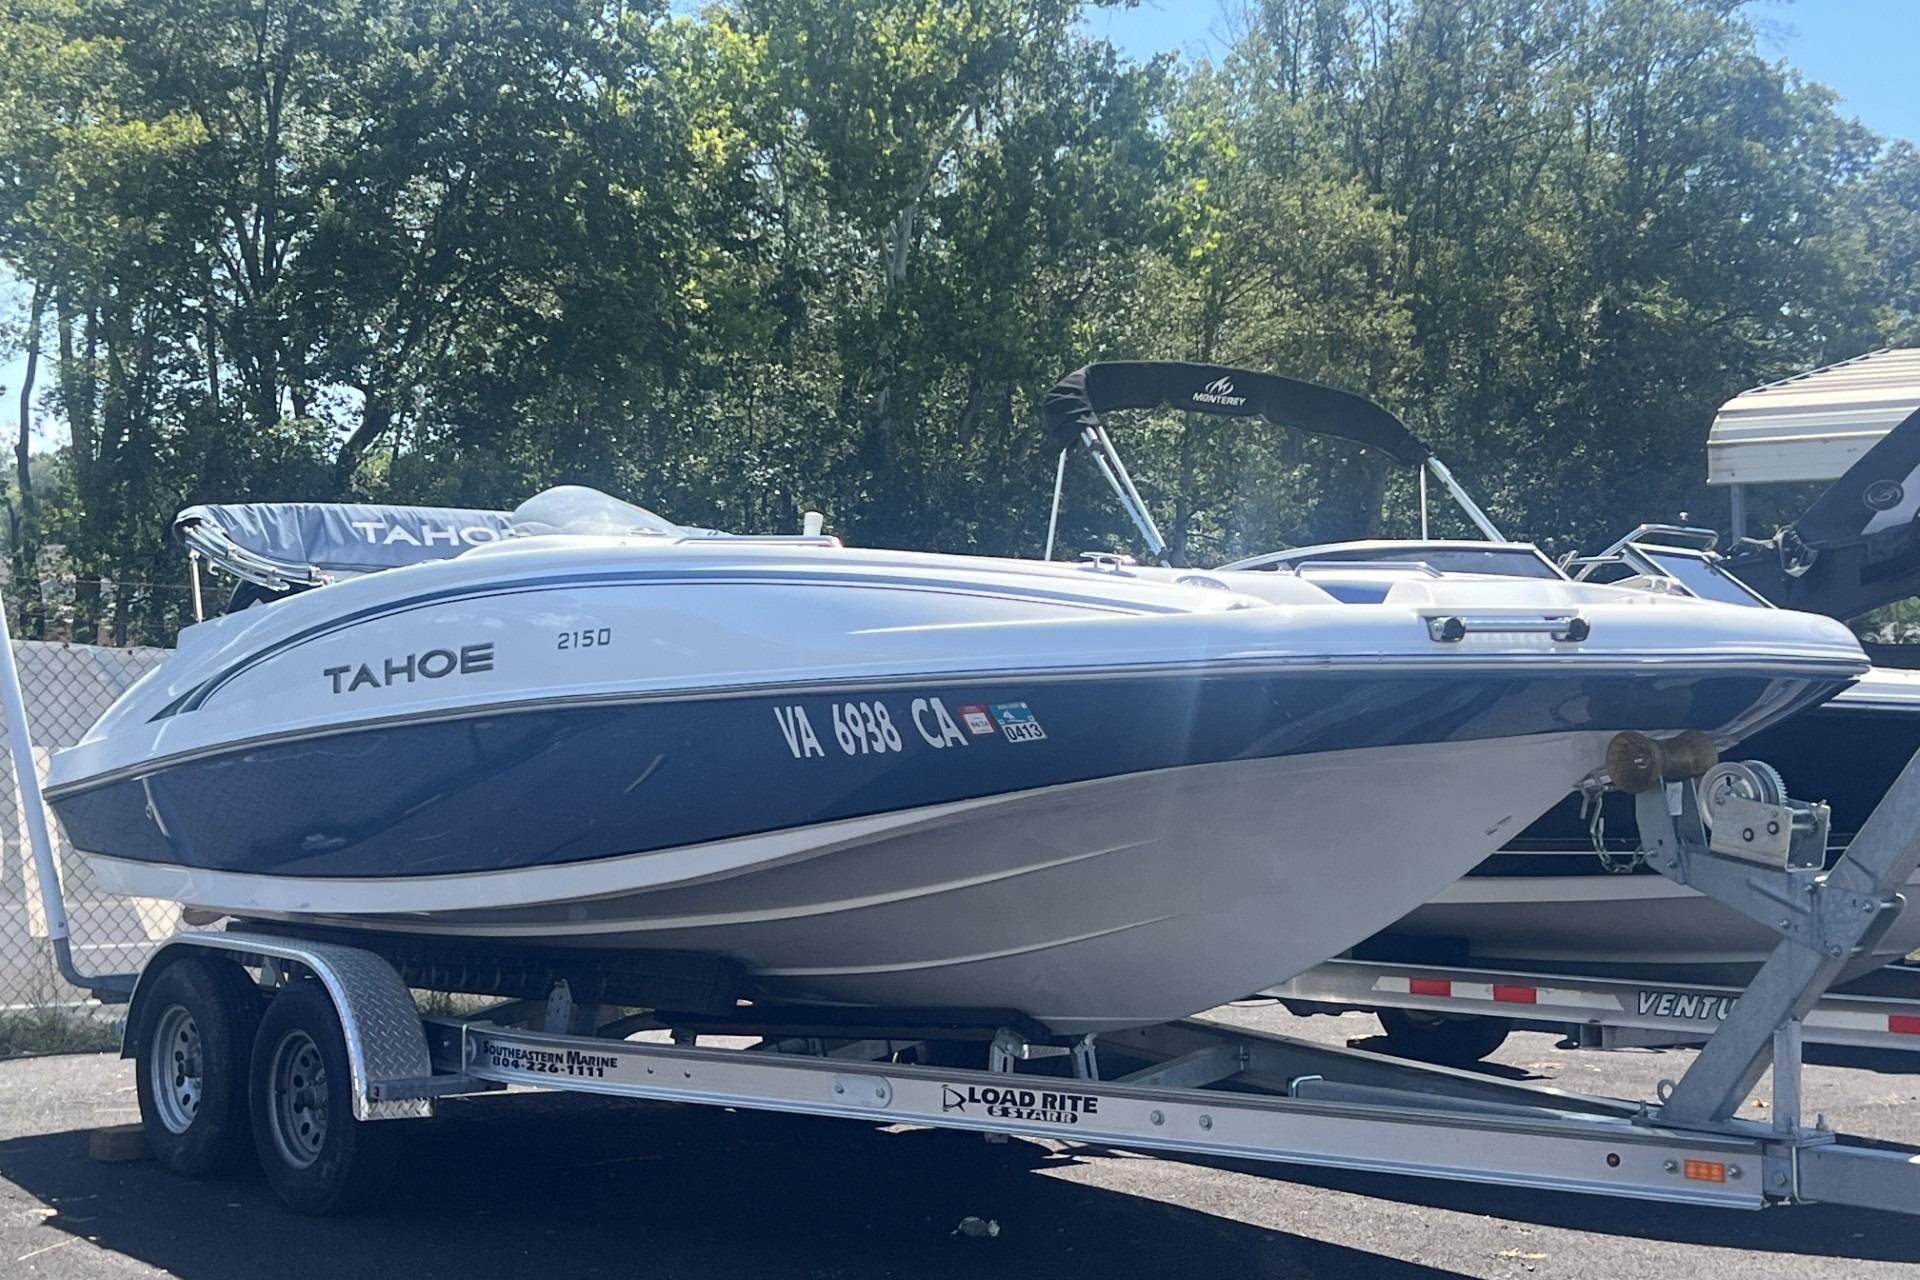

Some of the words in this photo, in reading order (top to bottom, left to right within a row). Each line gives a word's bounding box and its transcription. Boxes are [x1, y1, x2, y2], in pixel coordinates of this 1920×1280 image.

[1192, 392, 1247, 406] MONTEREY
[557, 628, 611, 650] 2150
[323, 641, 495, 694] TAHOE
[773, 705, 826, 758] VA
[832, 700, 902, 756] 6938
[911, 697, 969, 749] CA
[1004, 723, 1043, 740] 0413
[483, 1040, 563, 1064] SOUTHEASTERN
[566, 1050, 618, 1069] MARINE
[492, 1055, 604, 1078] 804-226-1111
[968, 1086, 1036, 1108] LOAD
[1042, 1093, 1099, 1114] RITE
